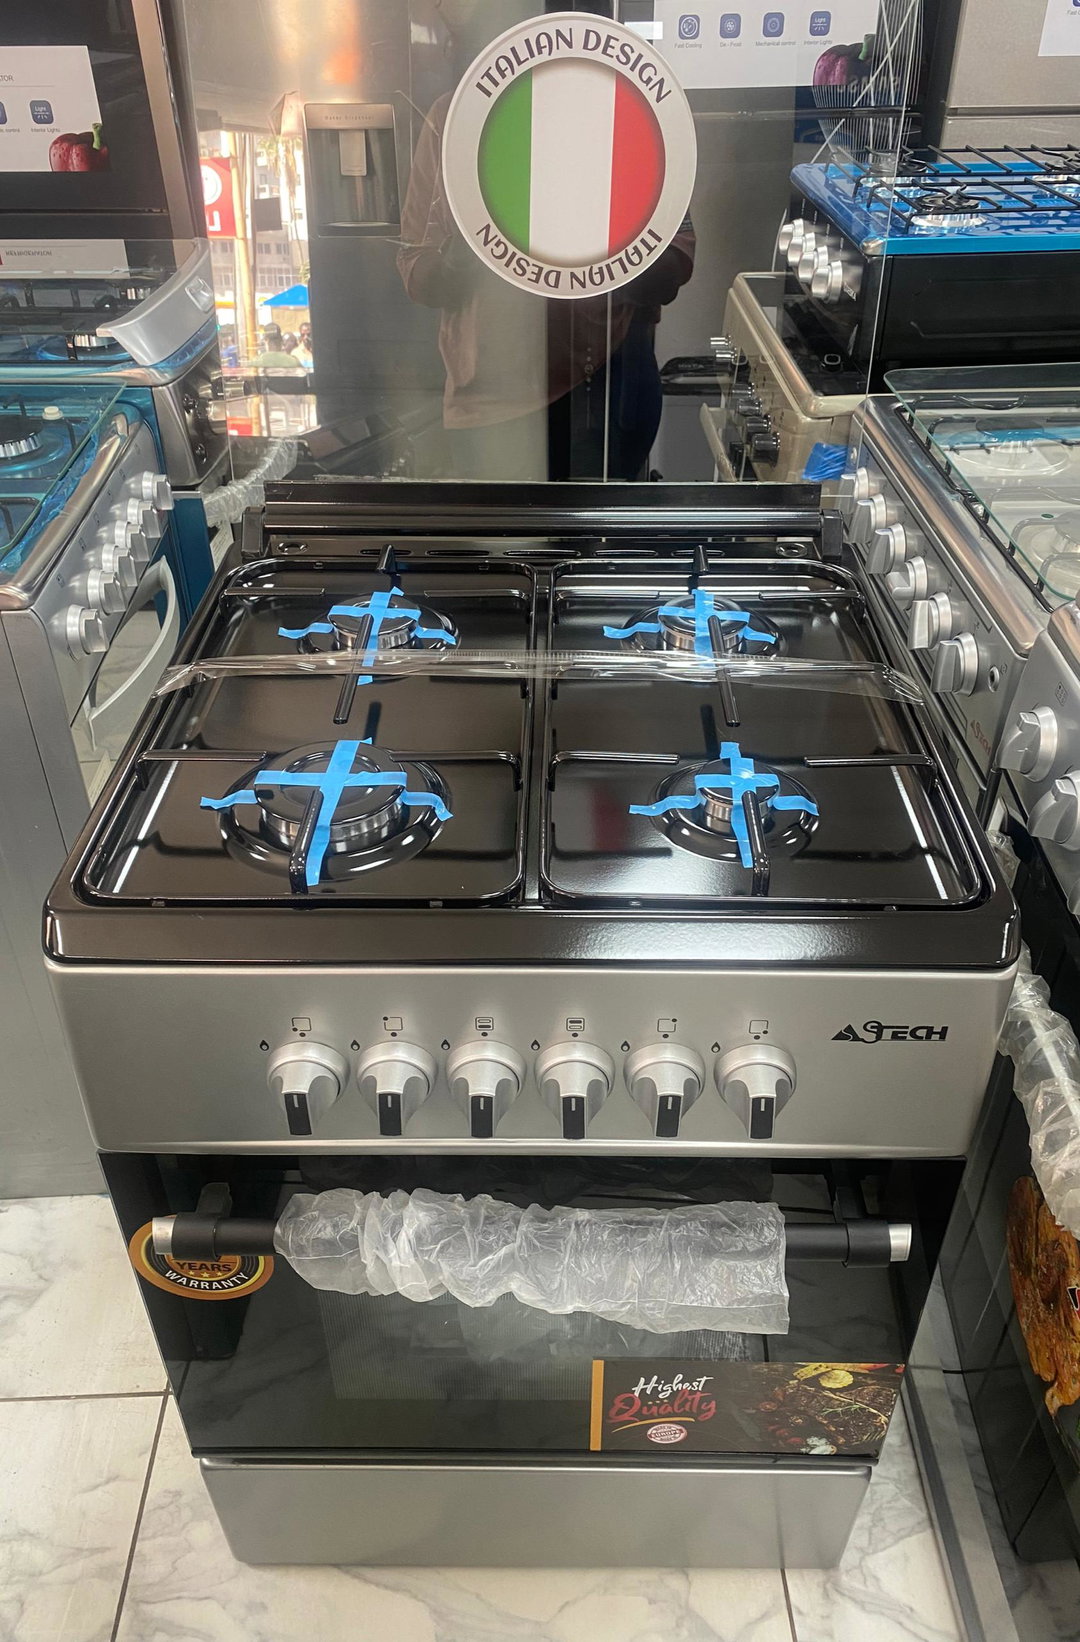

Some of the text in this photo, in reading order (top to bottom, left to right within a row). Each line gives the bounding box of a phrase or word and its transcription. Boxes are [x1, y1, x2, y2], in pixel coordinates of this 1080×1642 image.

[475, 27, 672, 104] ITALIAN DESIGN
[475, 222, 663, 290] ITALIAN DESIGN
[164, 1269, 249, 1290] WARRANTY
[176, 1261, 232, 1272] YEARS
[631, 1373, 714, 1399] Highest
[607, 1389, 718, 1424] Quality
